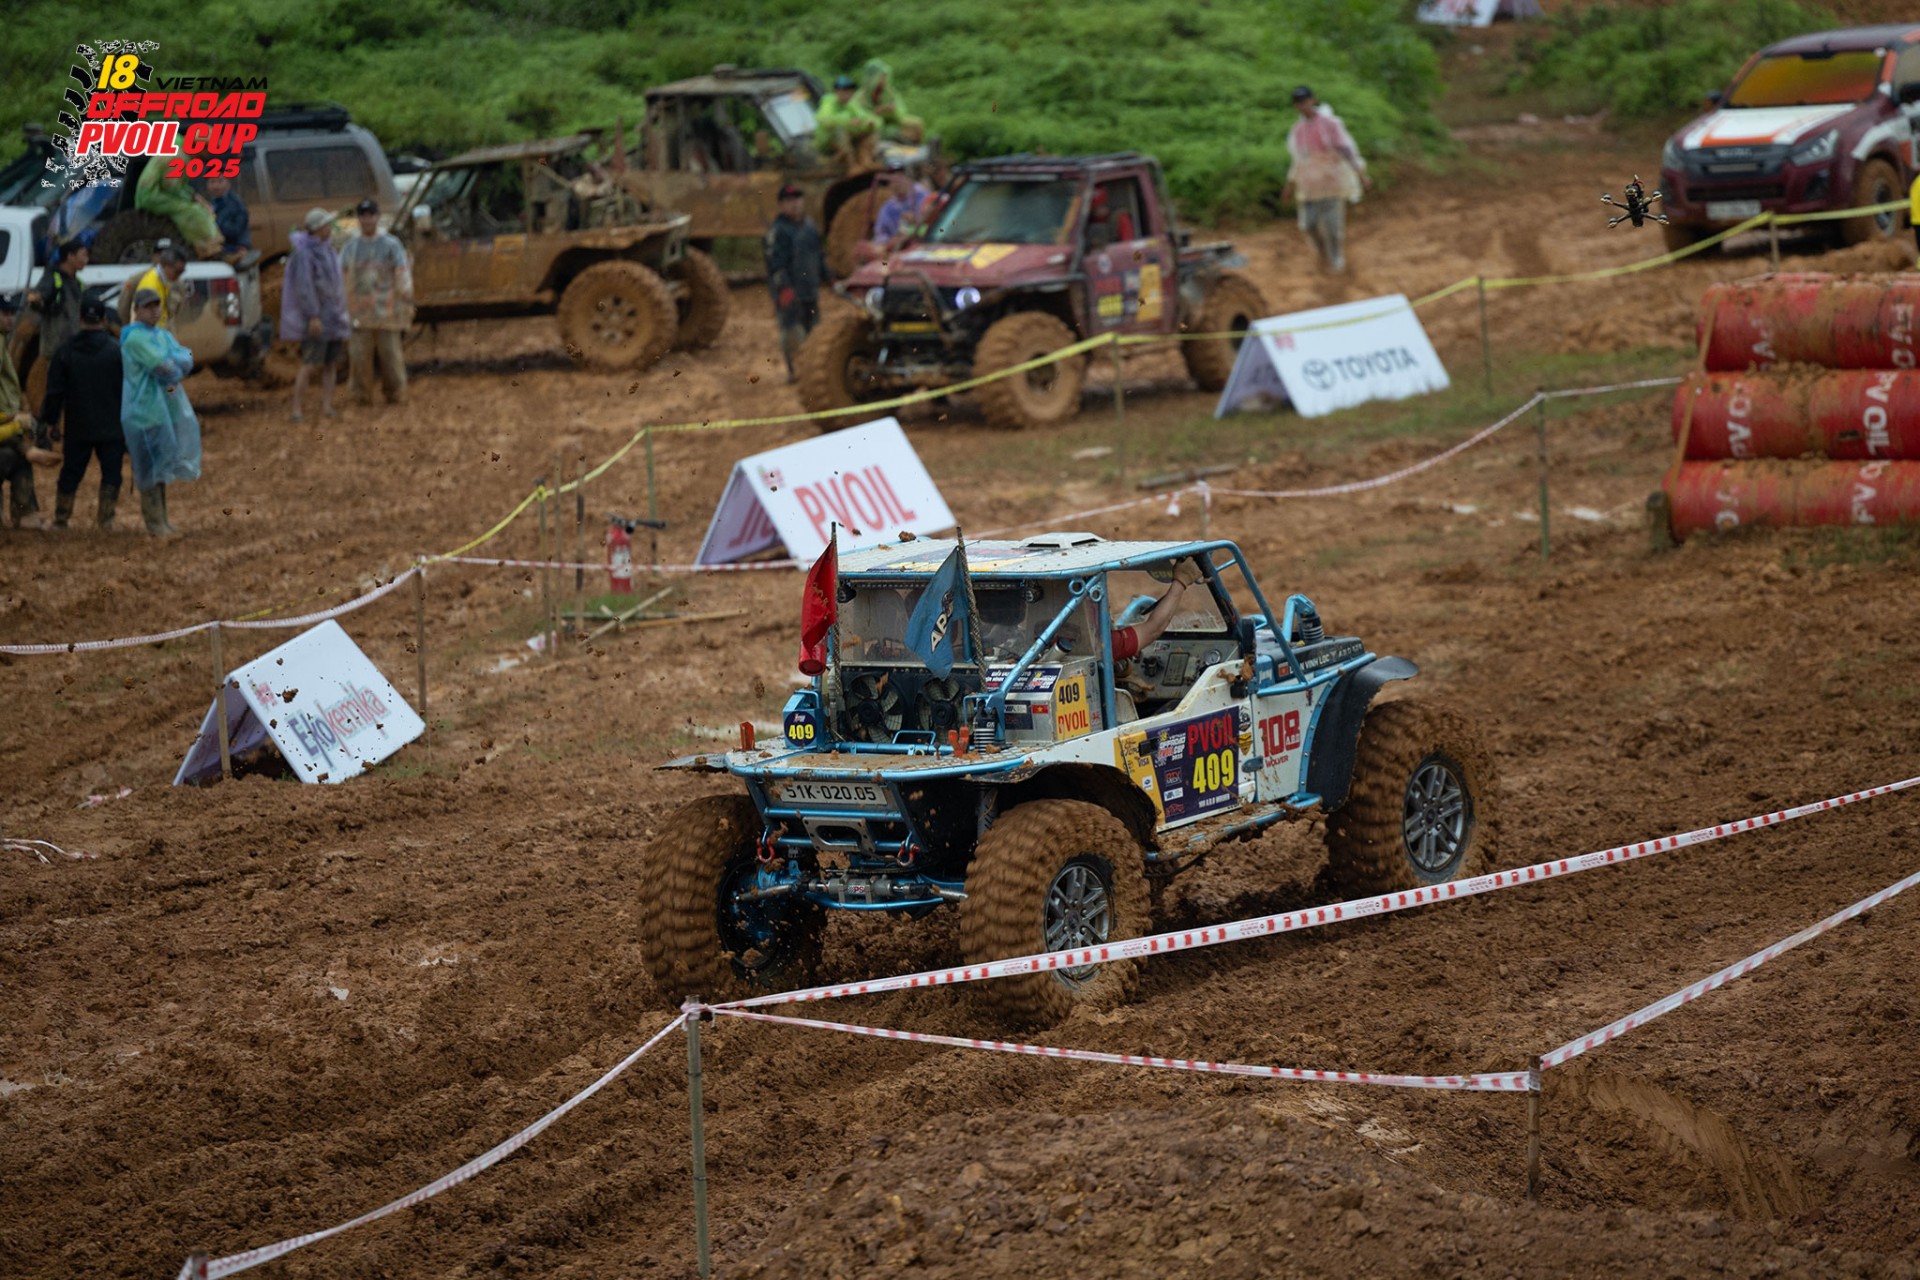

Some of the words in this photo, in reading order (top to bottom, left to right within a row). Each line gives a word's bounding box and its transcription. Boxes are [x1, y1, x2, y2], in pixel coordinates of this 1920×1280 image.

[1333, 348, 1419, 381] TOYOTA
[793, 464, 917, 545] PVOIL
[1058, 682, 1080, 705] 409
[788, 724, 814, 740] 409
[1058, 709, 1088, 734] PVOIL
[1187, 715, 1237, 756] PVOIL
[1259, 709, 1300, 758] 108
[1193, 748, 1235, 793] 409
[787, 784, 878, 802] 51K-020.05
